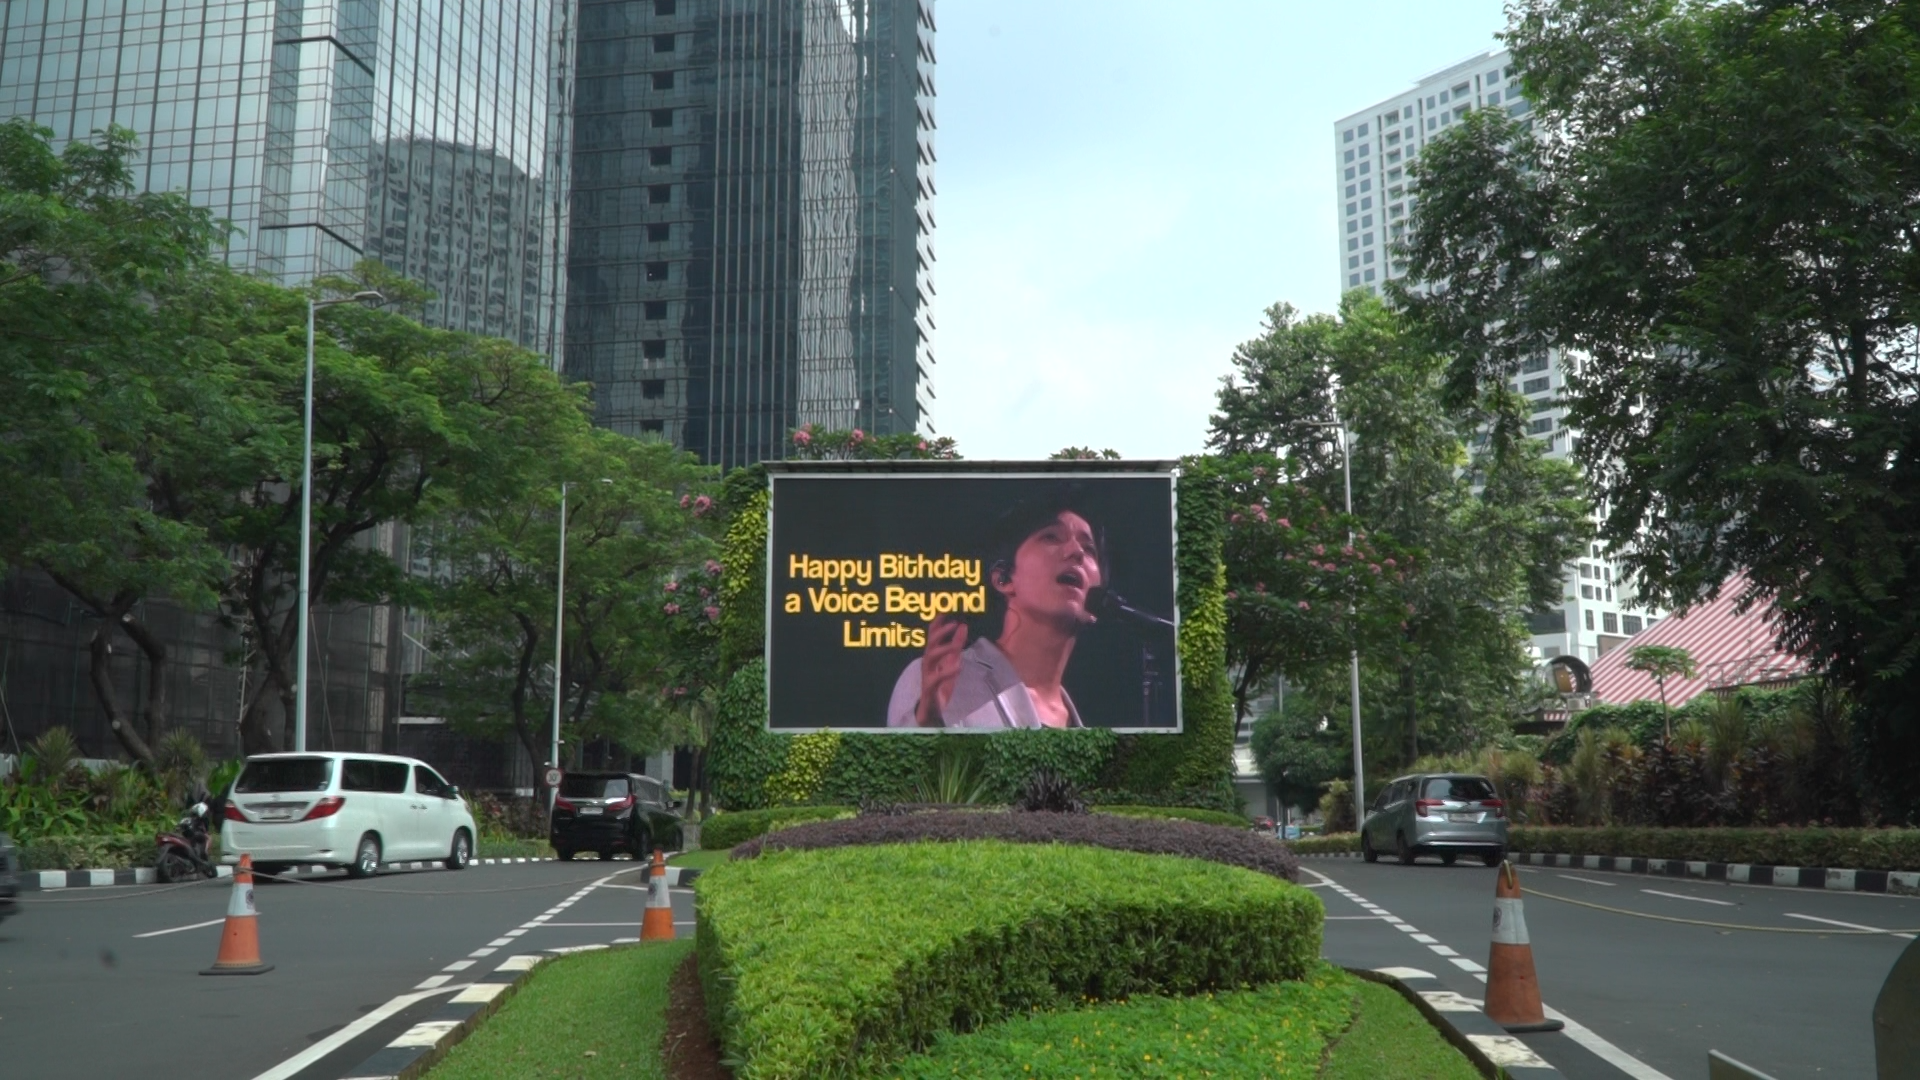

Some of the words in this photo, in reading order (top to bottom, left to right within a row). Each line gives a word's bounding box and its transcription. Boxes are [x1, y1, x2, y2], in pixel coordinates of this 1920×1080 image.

[789, 553, 873, 586] Happy
[879, 553, 981, 586] Bithday
[784, 592, 801, 613] a
[808, 587, 879, 613] Voice
[885, 585, 986, 621] Beyond
[843, 620, 926, 648] Limits
